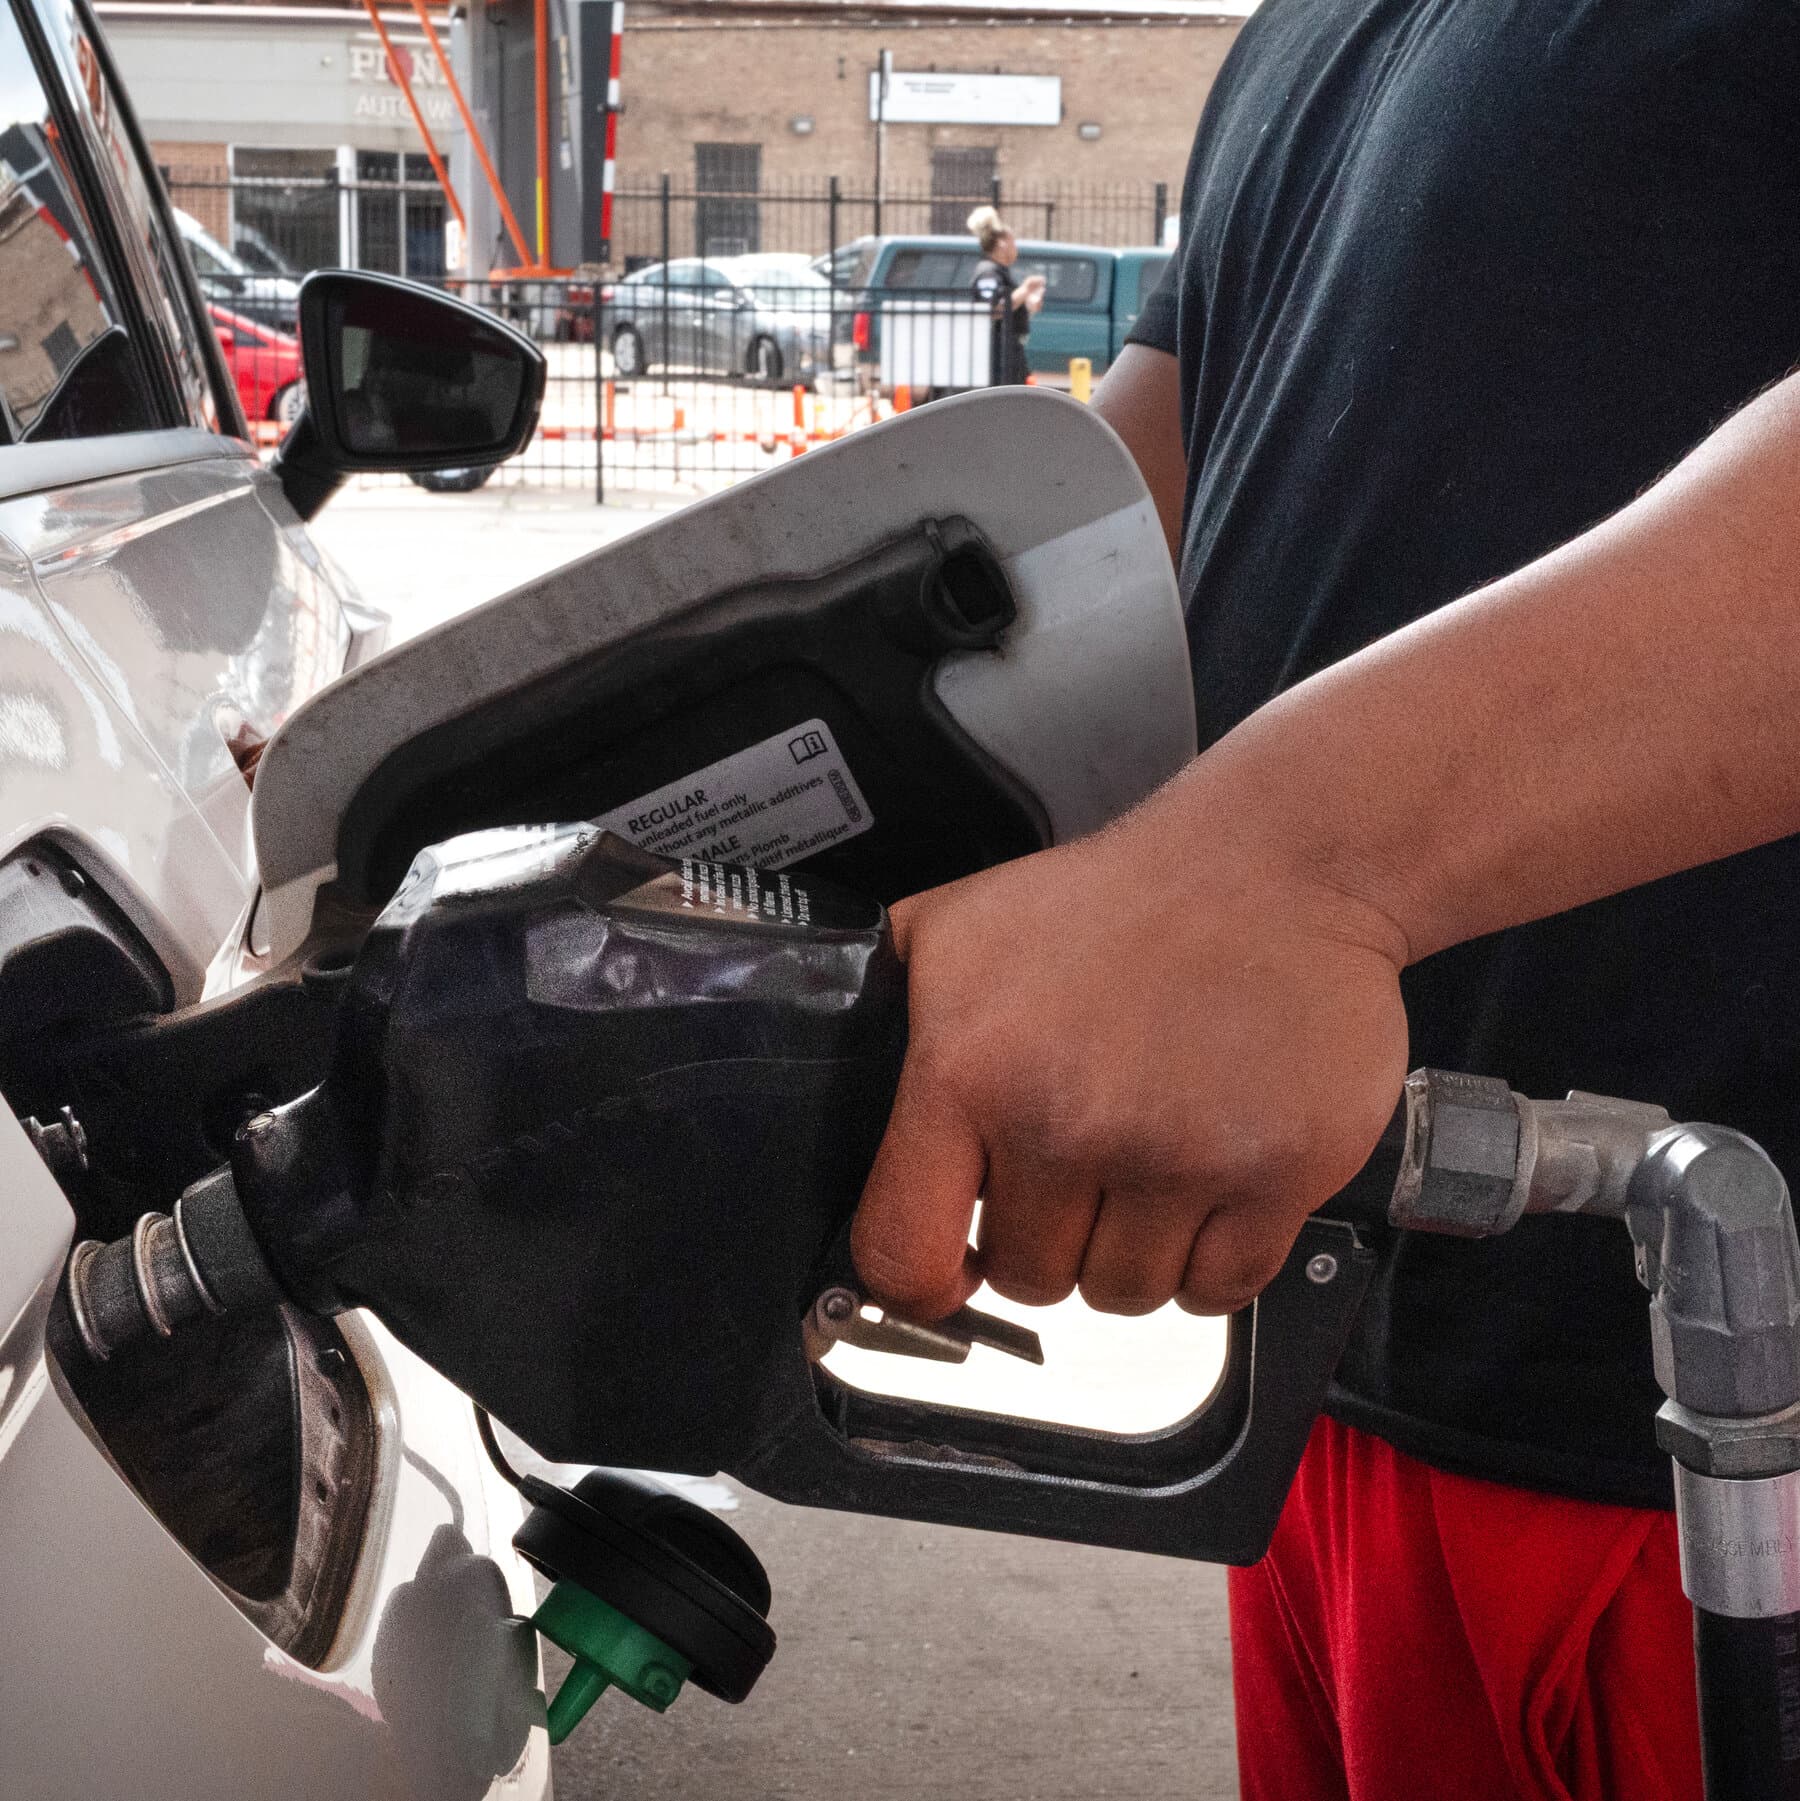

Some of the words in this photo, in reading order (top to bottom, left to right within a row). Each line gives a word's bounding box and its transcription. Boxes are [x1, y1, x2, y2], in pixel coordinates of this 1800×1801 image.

[628, 789, 709, 835] REGULAR
[638, 815, 694, 850] unleaded
[694, 803, 720, 823] fuel
[721, 793, 748, 811] only
[695, 824, 718, 840] any
[719, 799, 768, 829] metallic
[769, 777, 824, 807] additives
[691, 834, 741, 863] MALE
